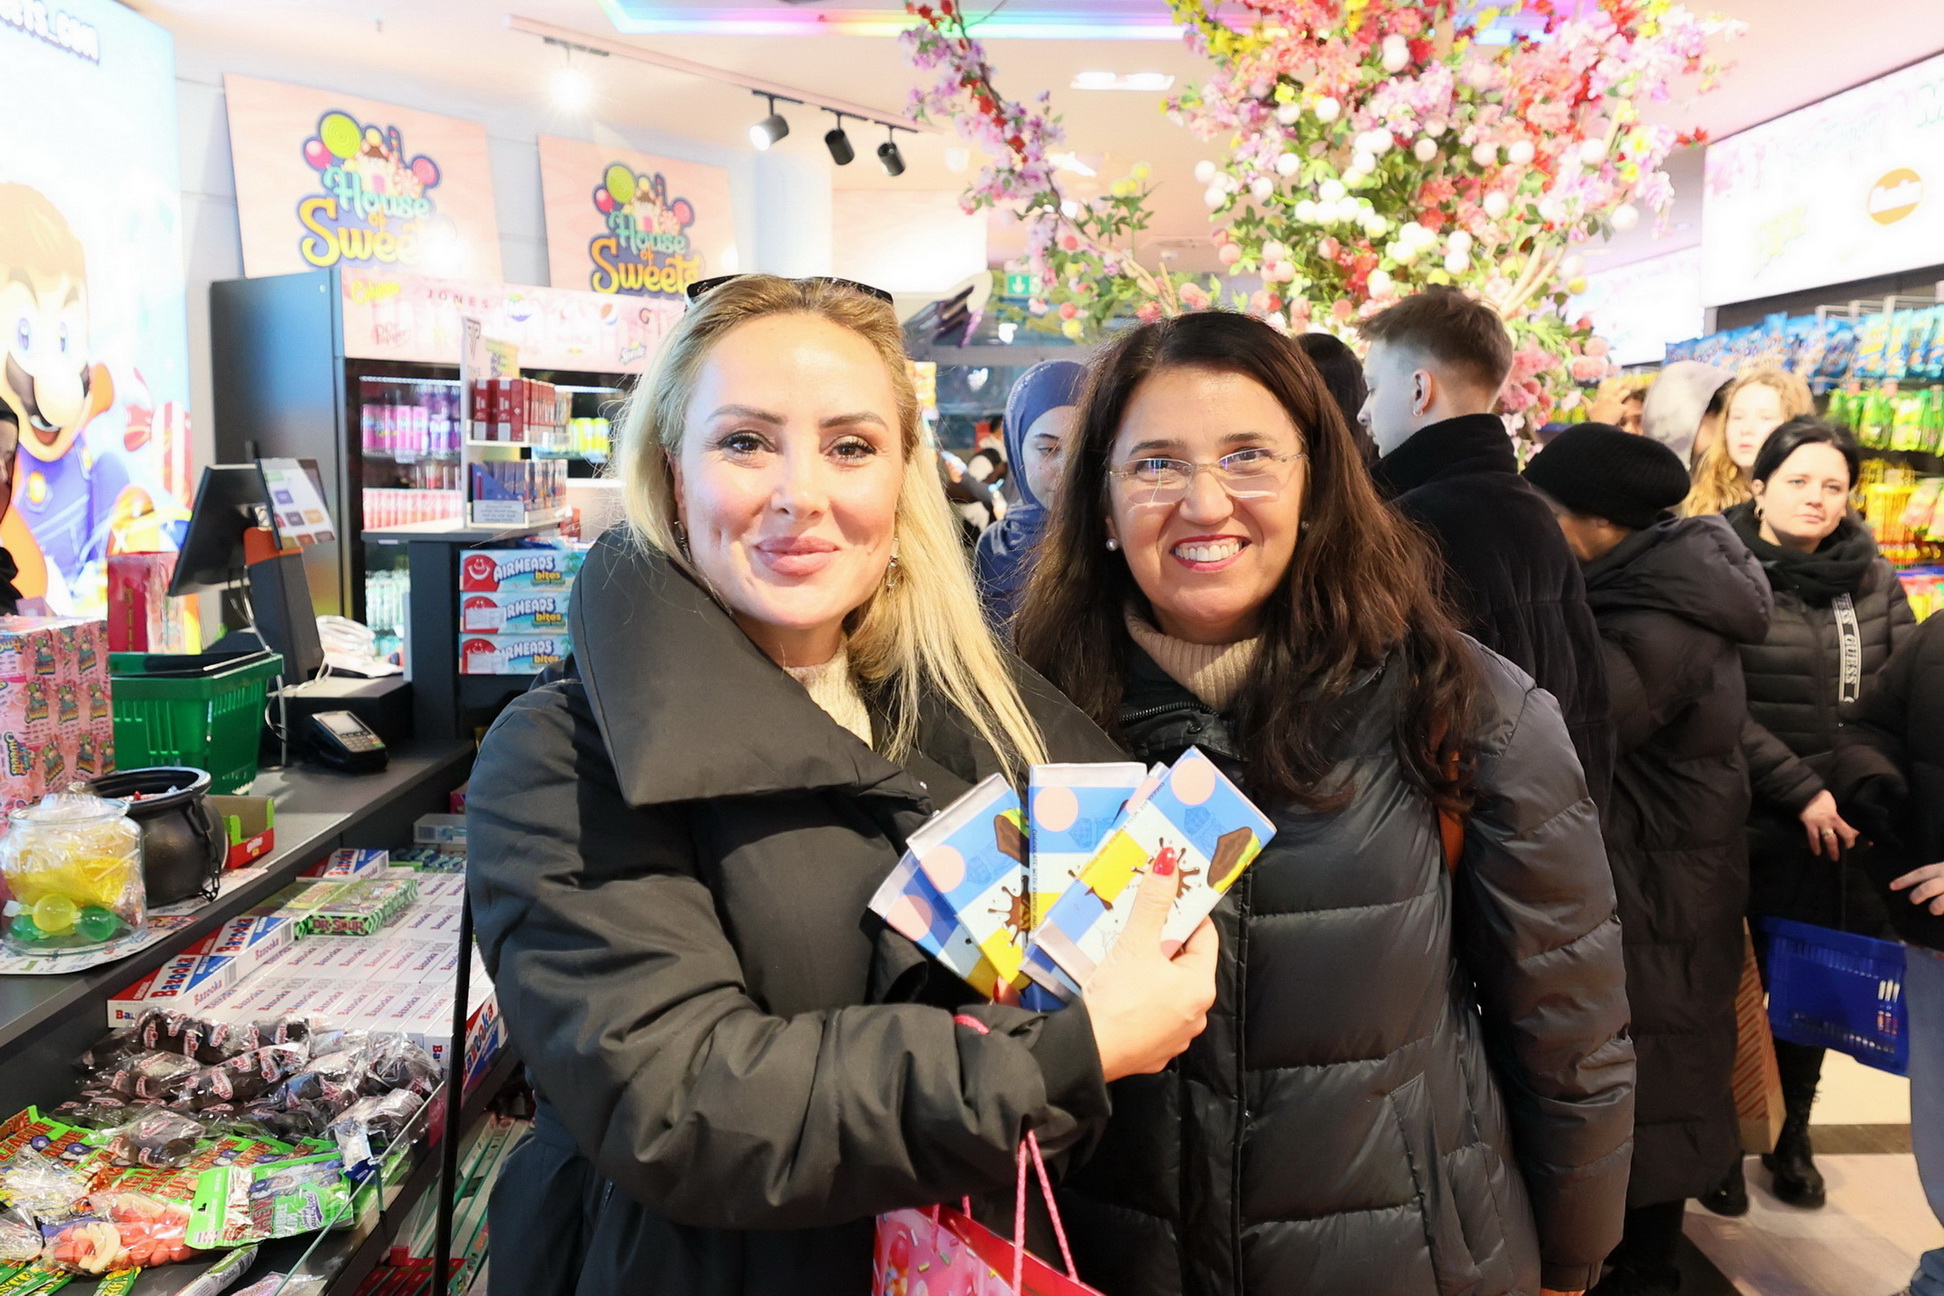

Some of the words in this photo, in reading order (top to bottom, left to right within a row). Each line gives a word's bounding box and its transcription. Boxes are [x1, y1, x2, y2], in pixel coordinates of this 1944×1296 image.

[323, 166, 430, 221] House
[608, 211, 686, 255] House
[640, 243, 655, 266] of
[428, 289, 490, 309] JONES
[494, 557, 554, 582] AIRHEADS
[535, 571, 561, 579] bites
[536, 612, 562, 621] bites
[1844, 633, 1857, 684] GUESS
[215, 918, 254, 953] Bazooka
[151, 957, 196, 998] Bazooka
